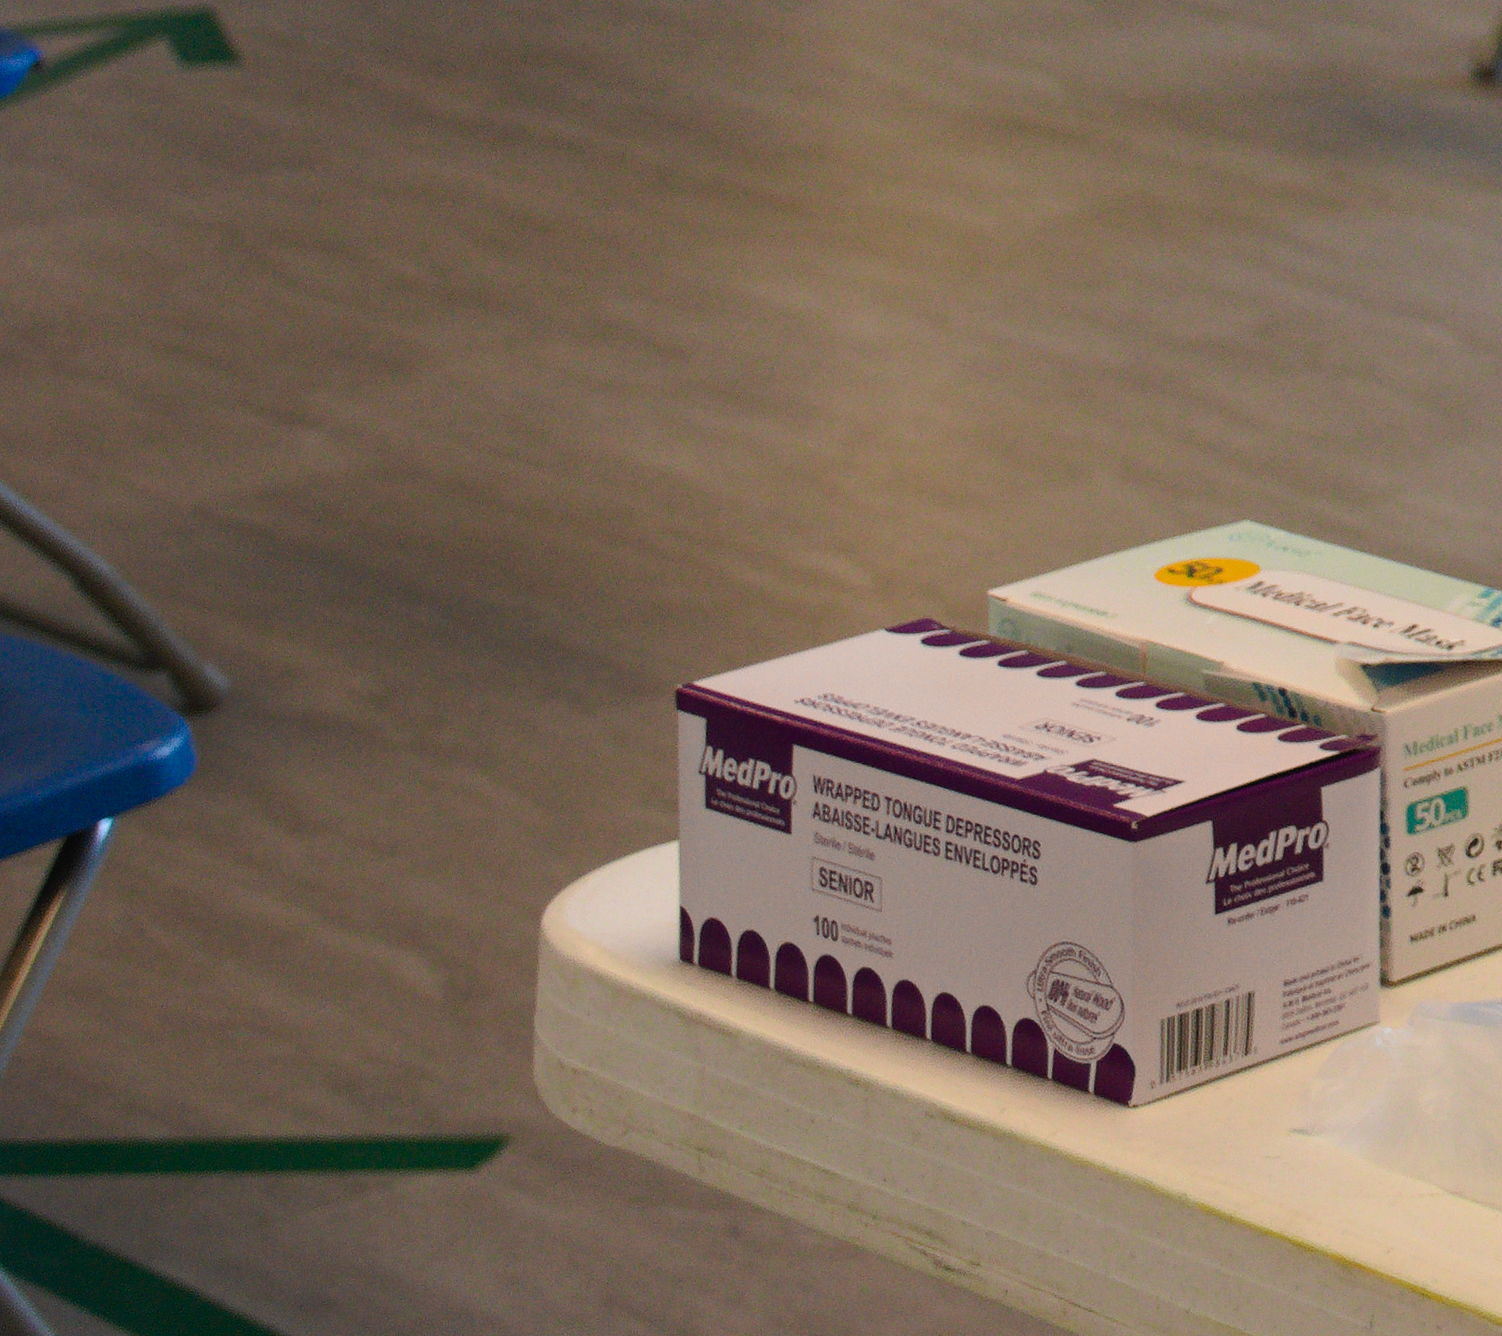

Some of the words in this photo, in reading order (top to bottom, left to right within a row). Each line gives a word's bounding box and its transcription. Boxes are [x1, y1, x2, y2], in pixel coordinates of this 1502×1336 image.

[1244, 580, 1344, 614] Medical
[1332, 606, 1395, 629] Face
[1395, 624, 1466, 651] Mask
[1403, 729, 1460, 757] Medical
[1463, 721, 1494, 741] Face
[699, 746, 797, 801] MedPro
[1403, 768, 1441, 790] Comply
[813, 775, 880, 811] WRAPPED
[884, 796, 942, 830] TONGUE
[945, 814, 1041, 860] DEPRESSORS
[1413, 796, 1447, 833] 50
[812, 801, 941, 857] ABAISSE-LANGUES
[944, 841, 1038, 886] ENVELOPPÉS
[1205, 821, 1330, 885] MedPro
[819, 867, 874, 903] SENIOR
[813, 915, 839, 942] 100
[1409, 927, 1436, 943] MADE
